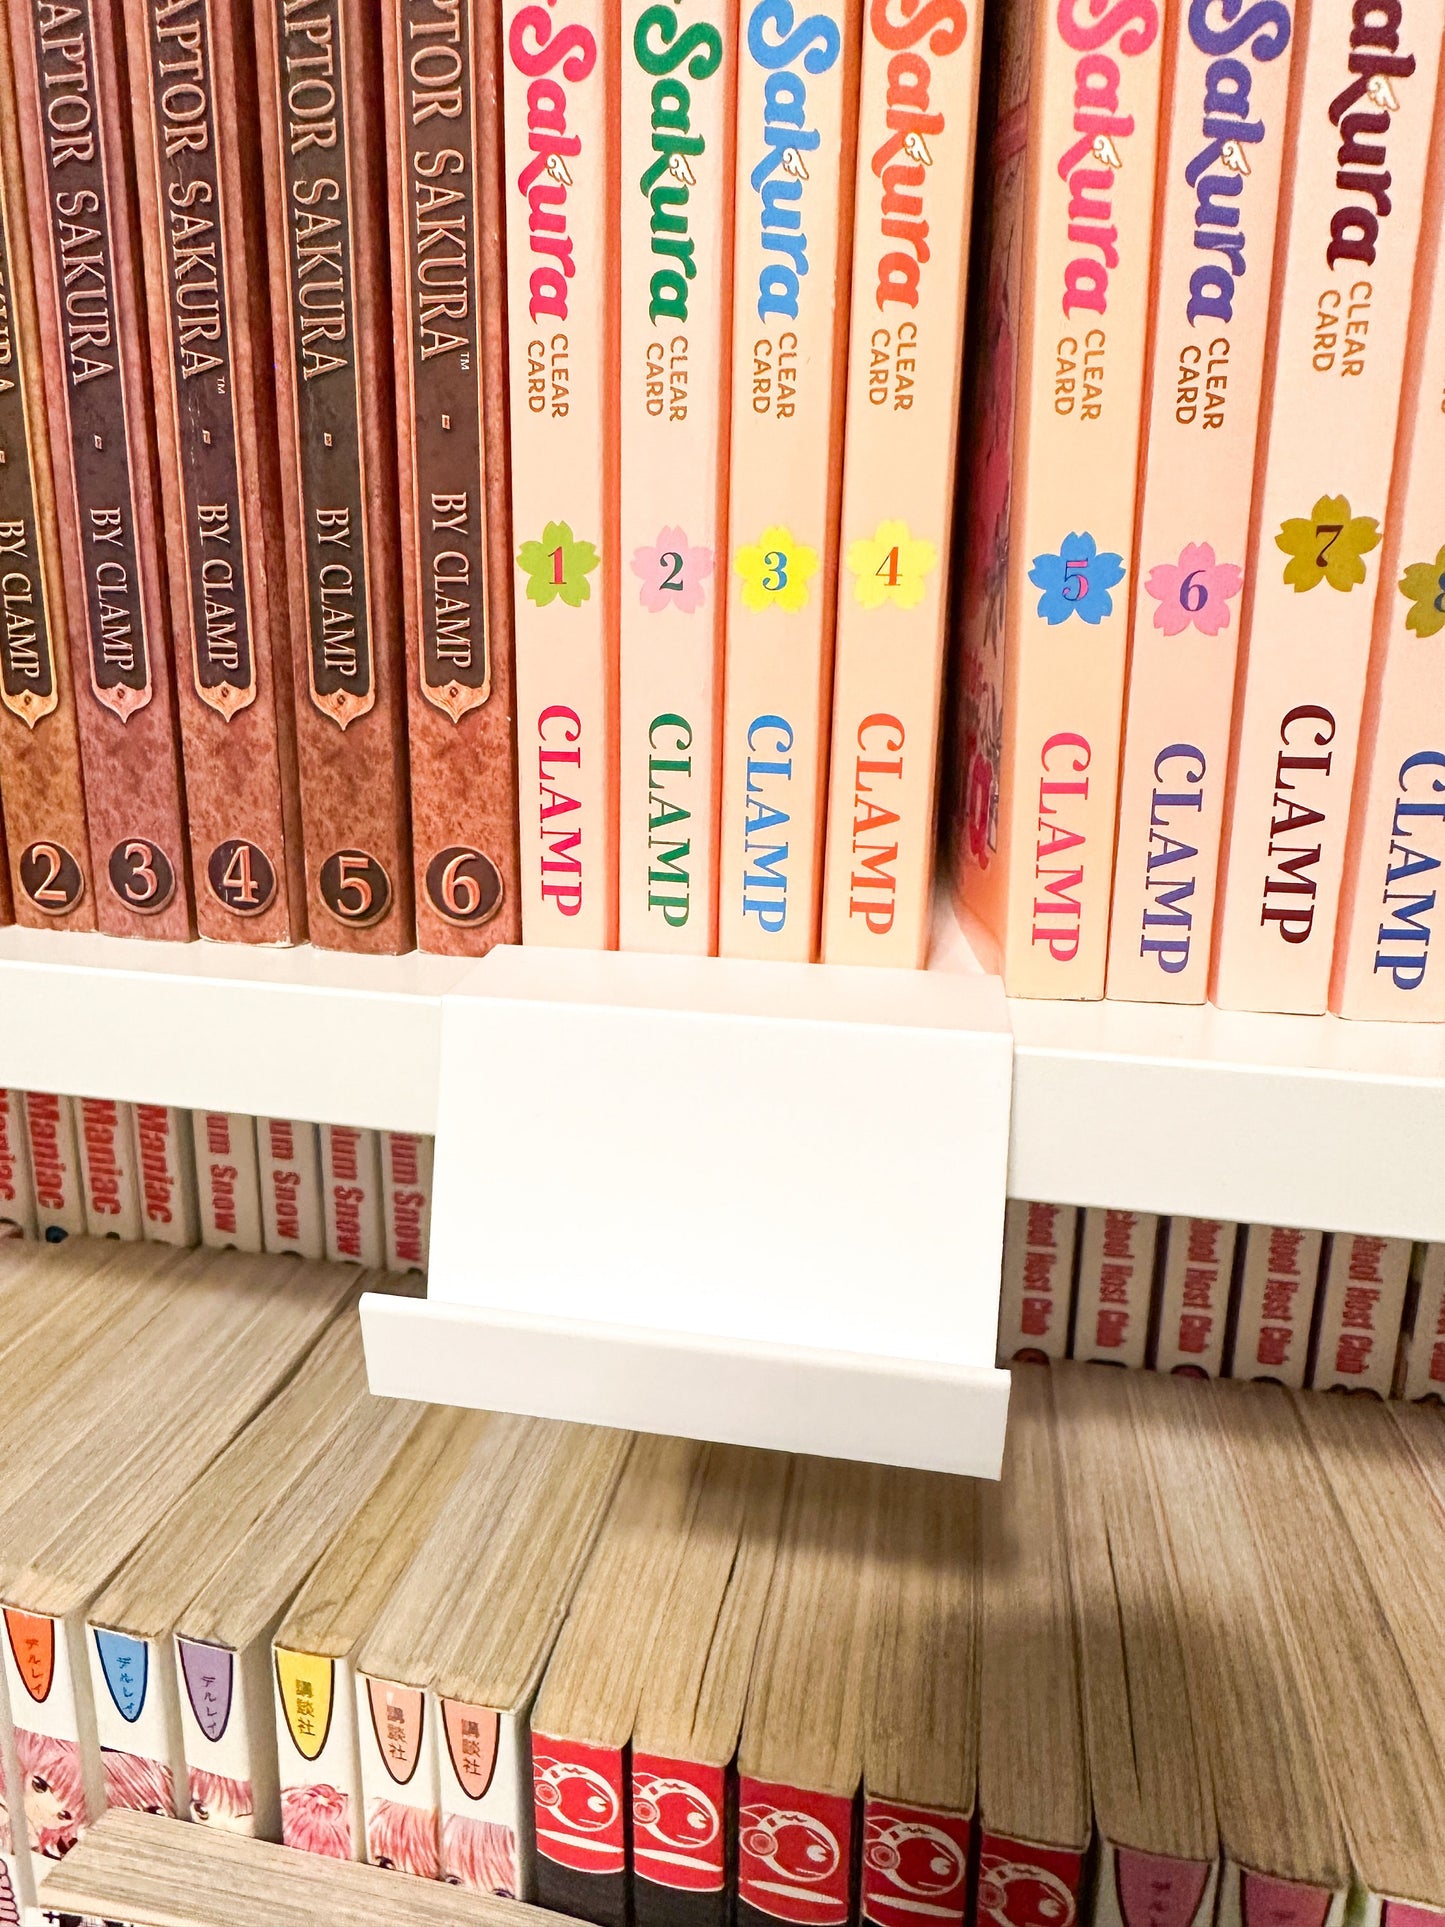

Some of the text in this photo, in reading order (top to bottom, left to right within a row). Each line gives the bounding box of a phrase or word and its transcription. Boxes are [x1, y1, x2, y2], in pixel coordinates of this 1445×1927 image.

[509, 5, 597, 325] Sakura
[633, 4, 723, 327] Sakura
[747, 0, 841, 325] Sakura
[870, 0, 968, 312] Sakura
[1057, 0, 1159, 320] Sakura
[1185, 0, 1292, 328] Sakura
[293, 177, 349, 382] SAKURA
[37, 0, 135, 672] APTOR SAKURA BY CLAMP
[869, 328, 890, 405] CARD
[894, 322, 917, 411] CLEAR
[1312, 290, 1341, 372] CARD
[1341, 281, 1373, 378] CLEAR
[527, 340, 545, 413] CARD
[550, 333, 570, 418] CLEAR
[646, 343, 663, 416] CARD
[669, 336, 688, 421] CLEAR
[752, 339, 772, 414] CARD
[777, 332, 798, 419] CLEAR
[1054, 337, 1078, 416] CARD
[1080, 329, 1106, 422] CLEAR
[1176, 345, 1201, 424] CARD
[1202, 338, 1231, 430] CLEAR
[196, 503, 231, 546] BY
[316, 507, 351, 548] BY
[431, 491, 467, 534] BY
[1315, 524, 1344, 568] 7
[548, 546, 567, 585] 1
[659, 552, 684, 591] 2
[762, 551, 788, 591] 3
[875, 547, 903, 586] 4
[1062, 560, 1089, 601] 5
[1179, 570, 1208, 612] 6
[1, 571, 40, 678] CLAMP
[201, 559, 239, 671] CLAMP
[318, 563, 357, 678] CLAMP
[433, 550, 472, 669] CLAMP
[538, 705, 582, 917] CLAMP
[647, 713, 693, 928] CLAMP
[742, 714, 794, 933] CLAMP
[849, 713, 905, 935] CLAMP
[1031, 732, 1092, 963] CLAMP
[1260, 704, 1336, 945] CLAMP
[32, 844, 67, 901] 2
[124, 842, 158, 900] 3
[223, 845, 259, 903] 4
[337, 857, 372, 915] 5
[441, 853, 480, 915] 6
[1140, 743, 1207, 975] CLAMP
[1374, 751, 1445, 991] CLAMP
[26, 1091, 66, 1209] Maniac
[81, 1097, 123, 1215] Maniac
[136, 1103, 174, 1223] Maniac
[210, 1163, 238, 1234] Snow
[273, 1169, 301, 1239] Snow
[334, 1186, 365, 1257] Snow
[393, 1190, 426, 1262] Snow
[1023, 1252, 1057, 1292] Host
[1099, 1263, 1134, 1304] Host
[1182, 1268, 1218, 1309] Host
[1261, 1278, 1299, 1321] Host
[1341, 1286, 1381, 1330] Host
